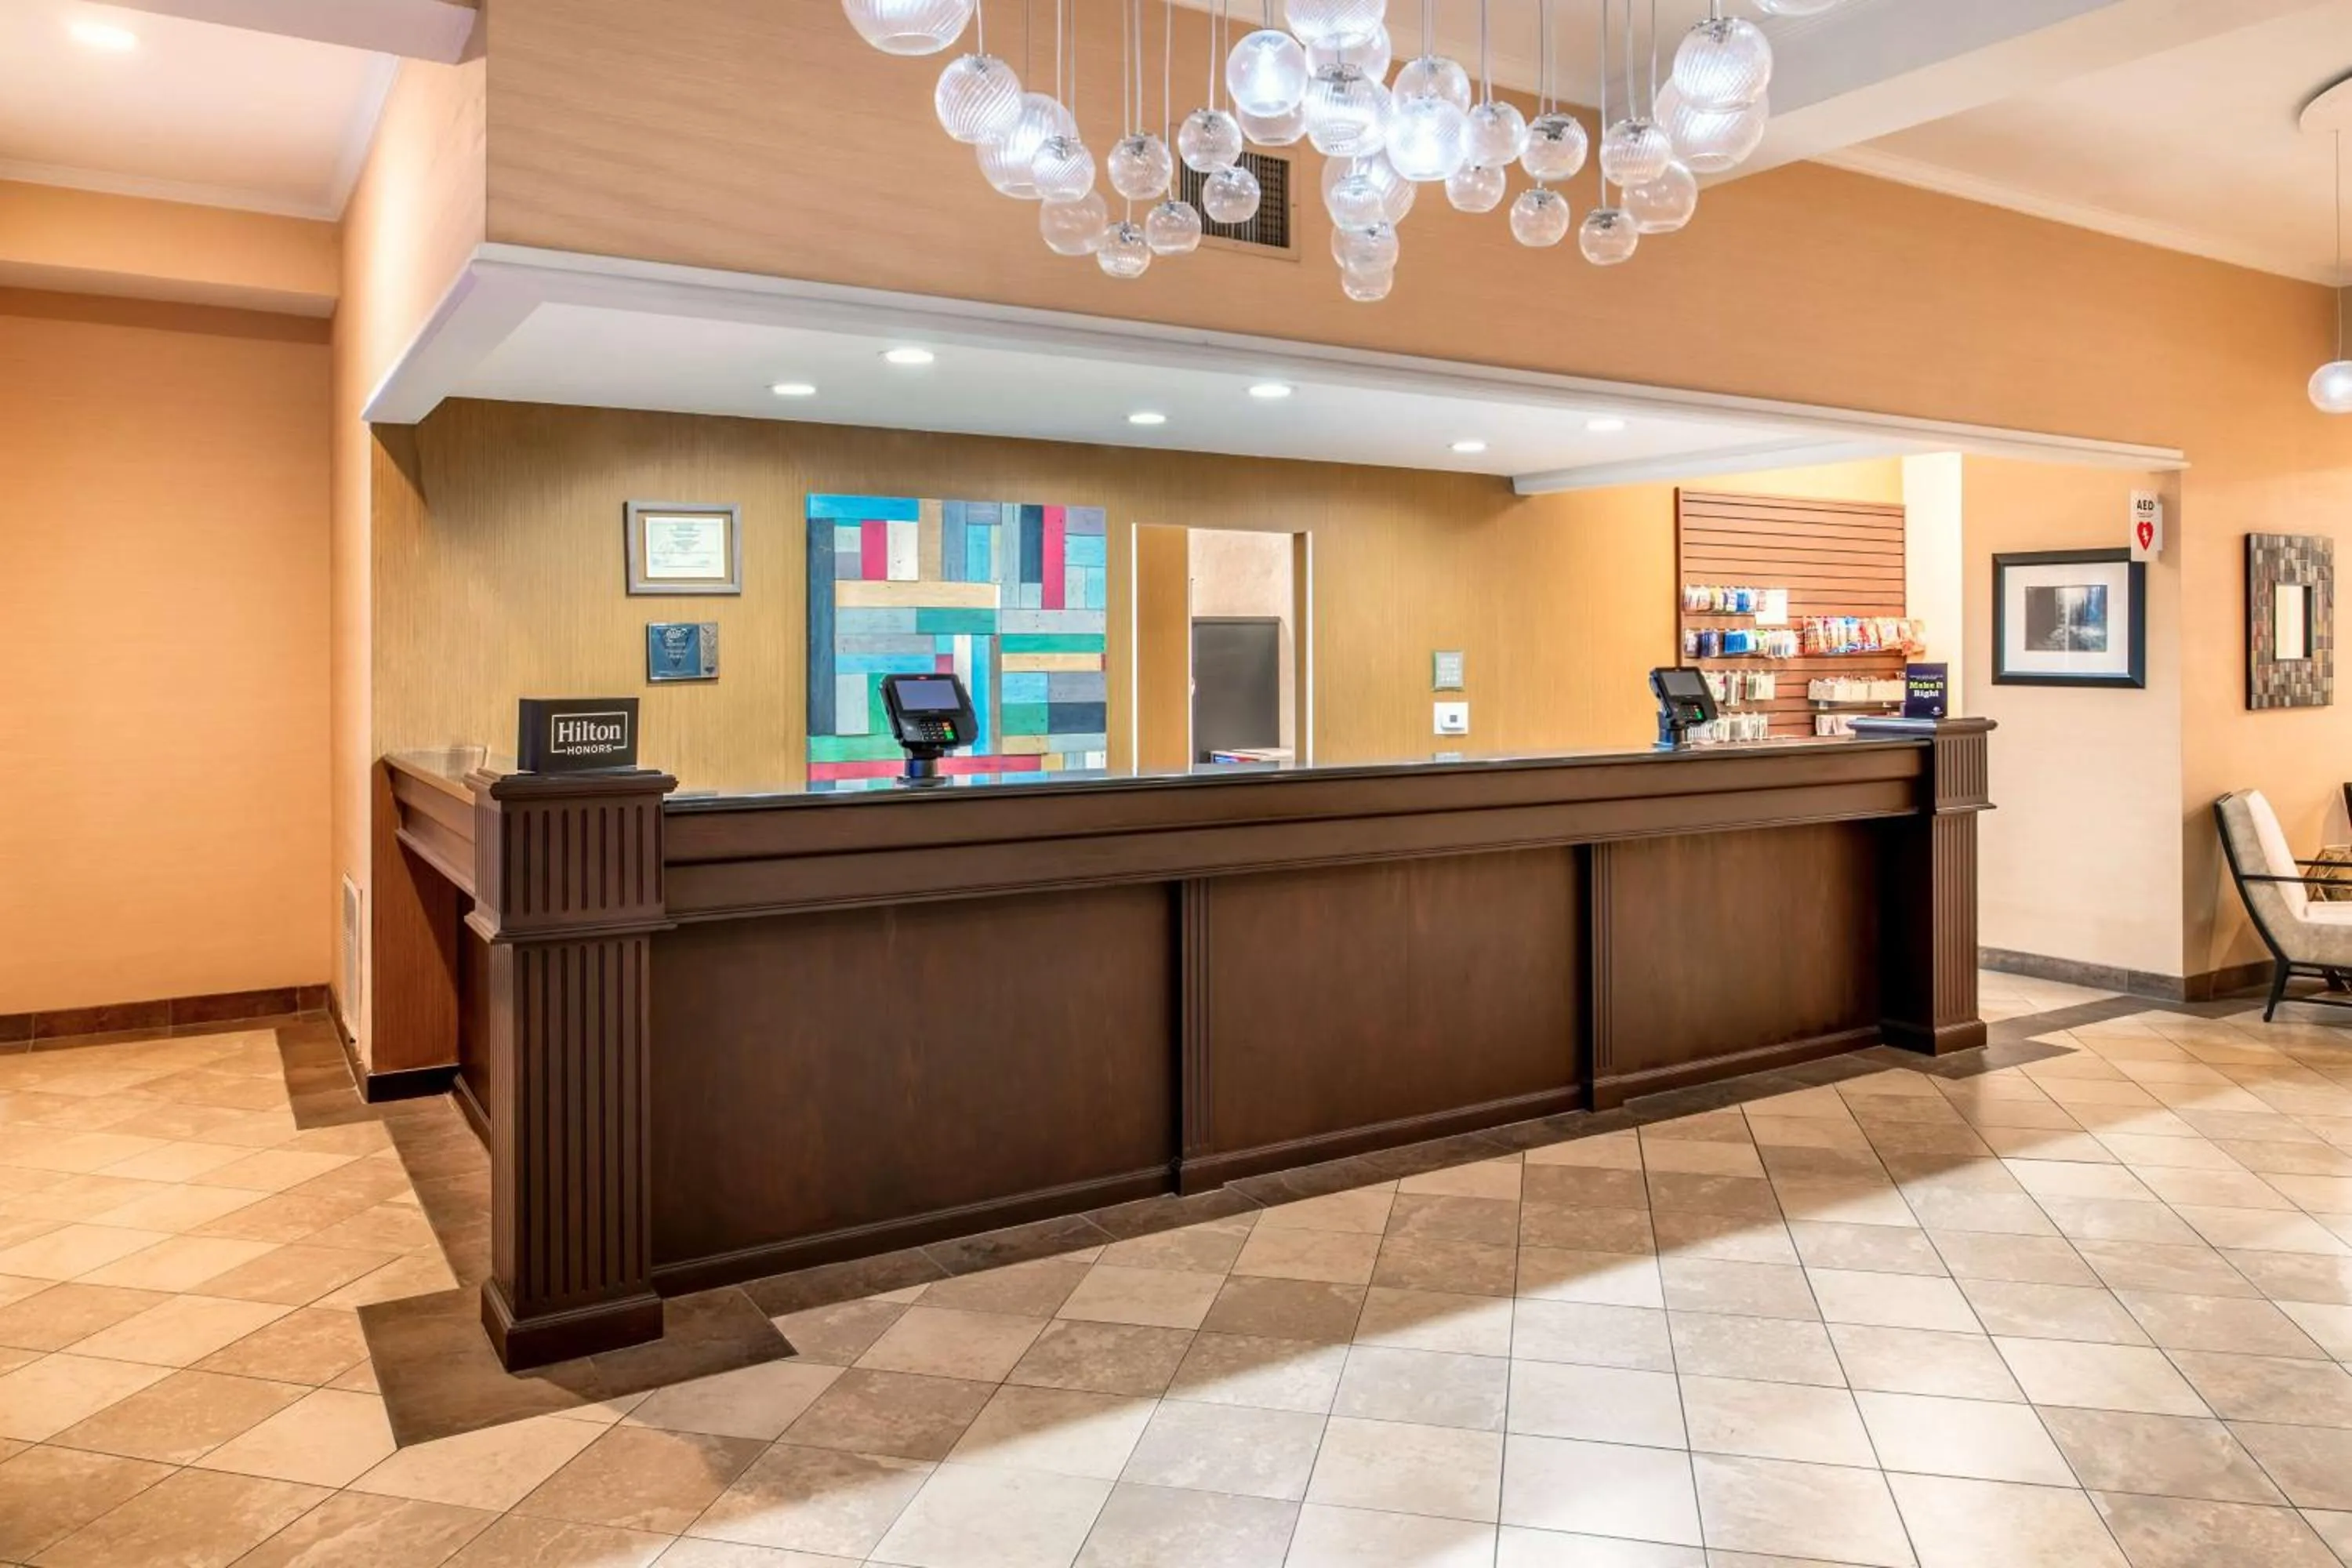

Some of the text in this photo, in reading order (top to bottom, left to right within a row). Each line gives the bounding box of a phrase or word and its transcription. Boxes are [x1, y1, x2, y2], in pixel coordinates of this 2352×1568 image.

[2136, 499, 2154, 510] AED
[1914, 690, 1939, 699] Right
[557, 720, 622, 742] Hilton
[567, 744, 613, 756] HONORS
